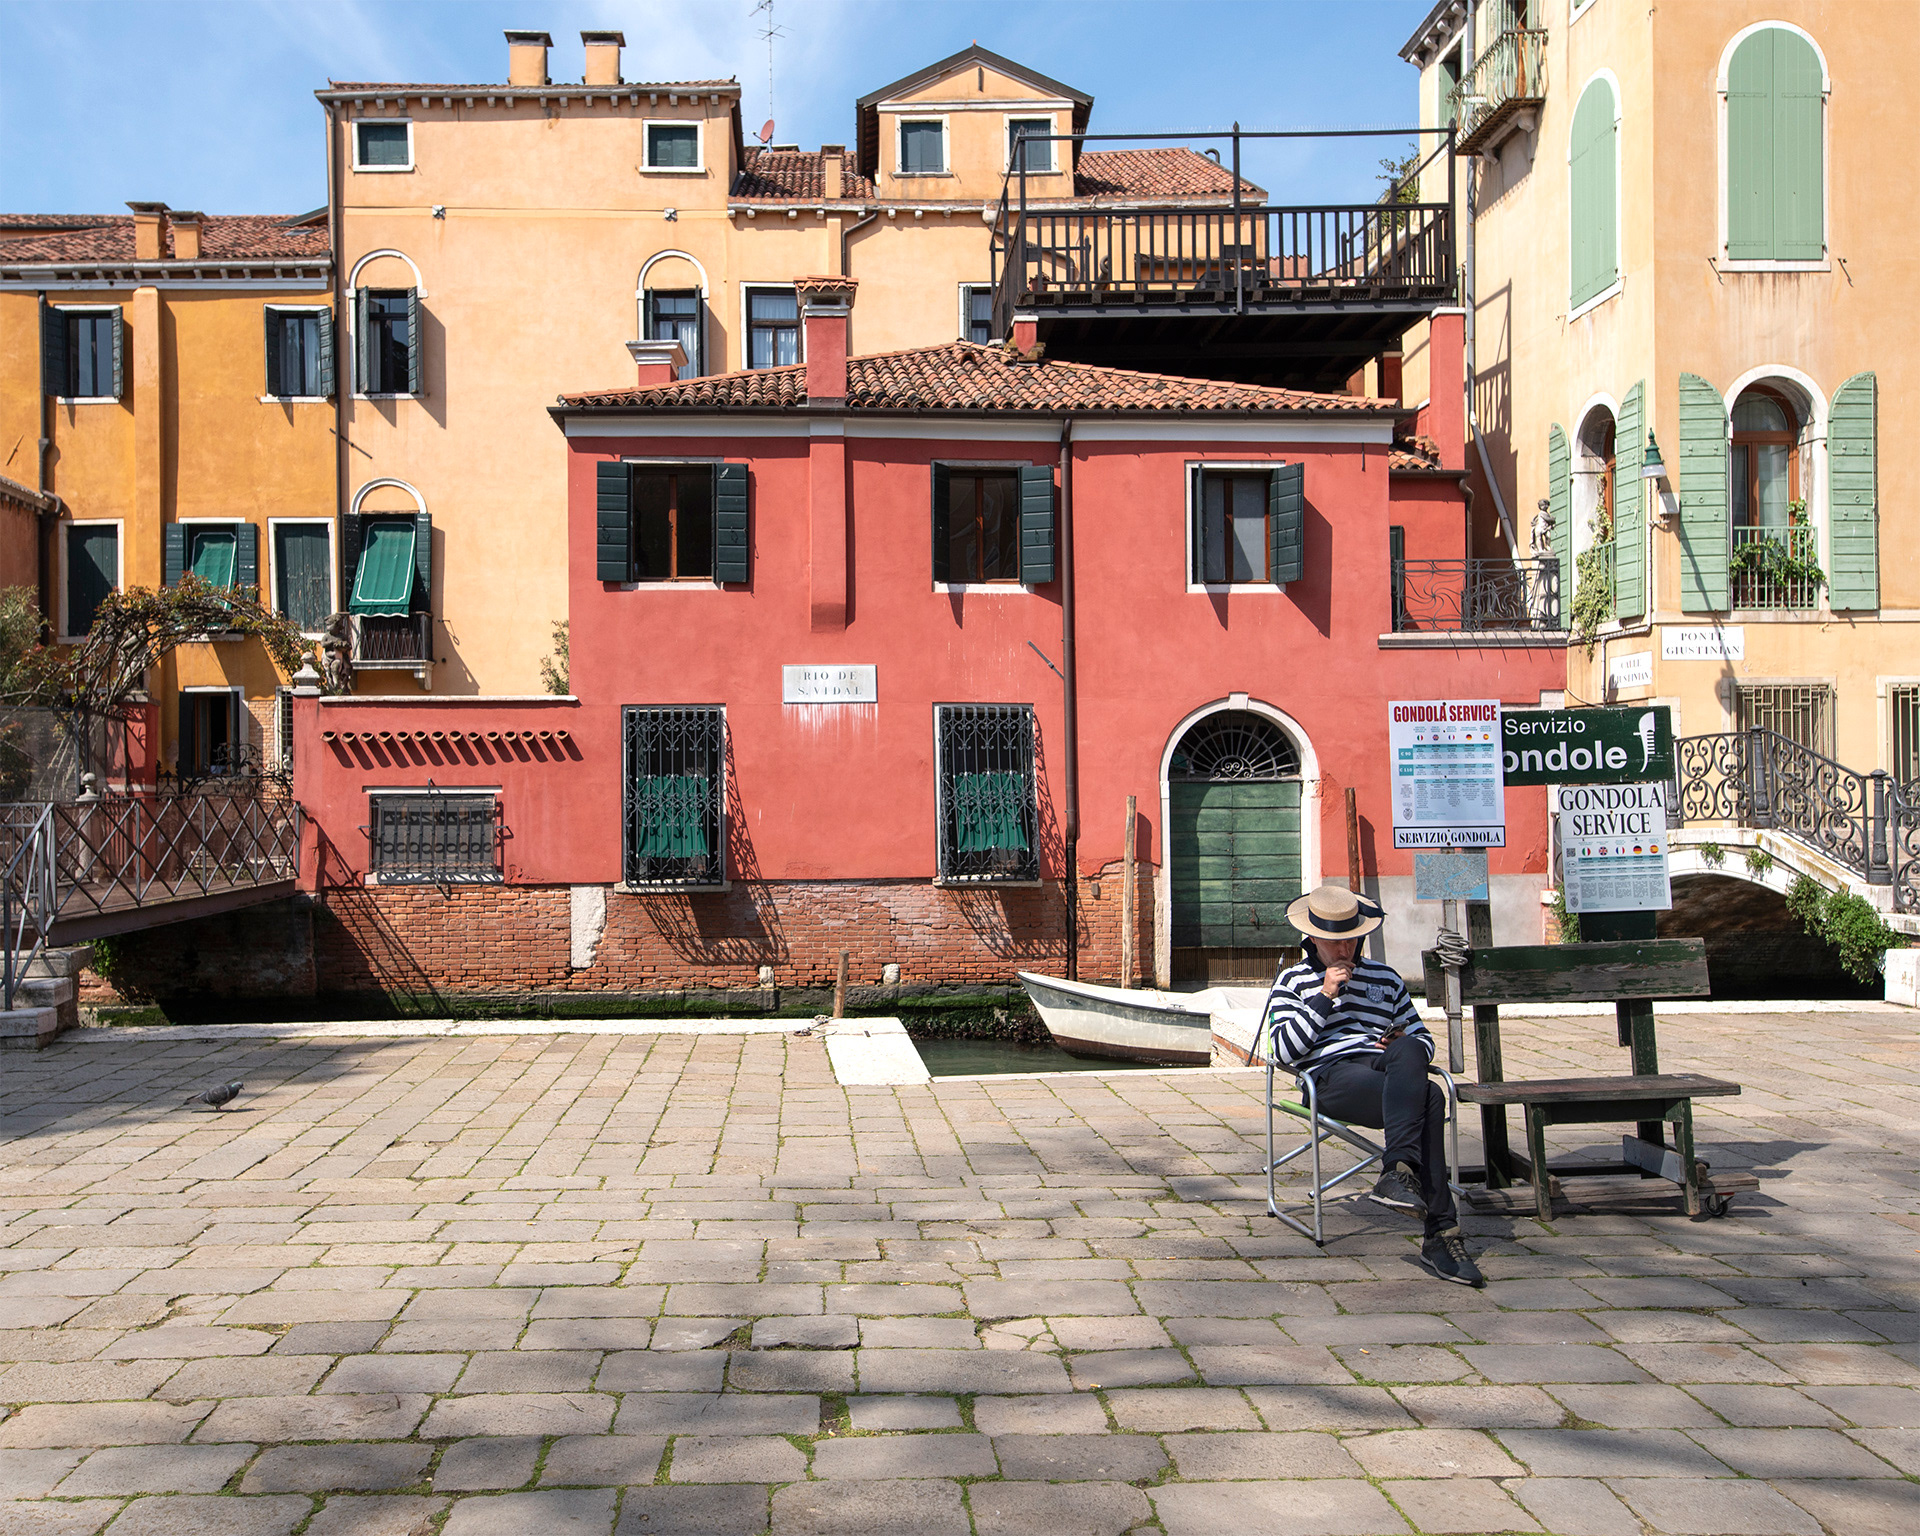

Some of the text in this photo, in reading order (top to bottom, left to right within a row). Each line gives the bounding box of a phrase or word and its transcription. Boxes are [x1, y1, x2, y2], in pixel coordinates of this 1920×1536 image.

[1681, 631, 1725, 641] PONTE
[1666, 645, 1740, 655] GIUSTINIAN
[804, 671, 857, 681] RIO DE
[1393, 704, 1497, 723] GONDOLA SERVICE
[1504, 716, 1586, 736] Servizio
[1502, 740, 1628, 773] ondole
[1560, 787, 1662, 811] GONDOLA
[1573, 813, 1651, 836] SERVICE
[1399, 831, 1501, 844] SERVIZIO GONDOLA
